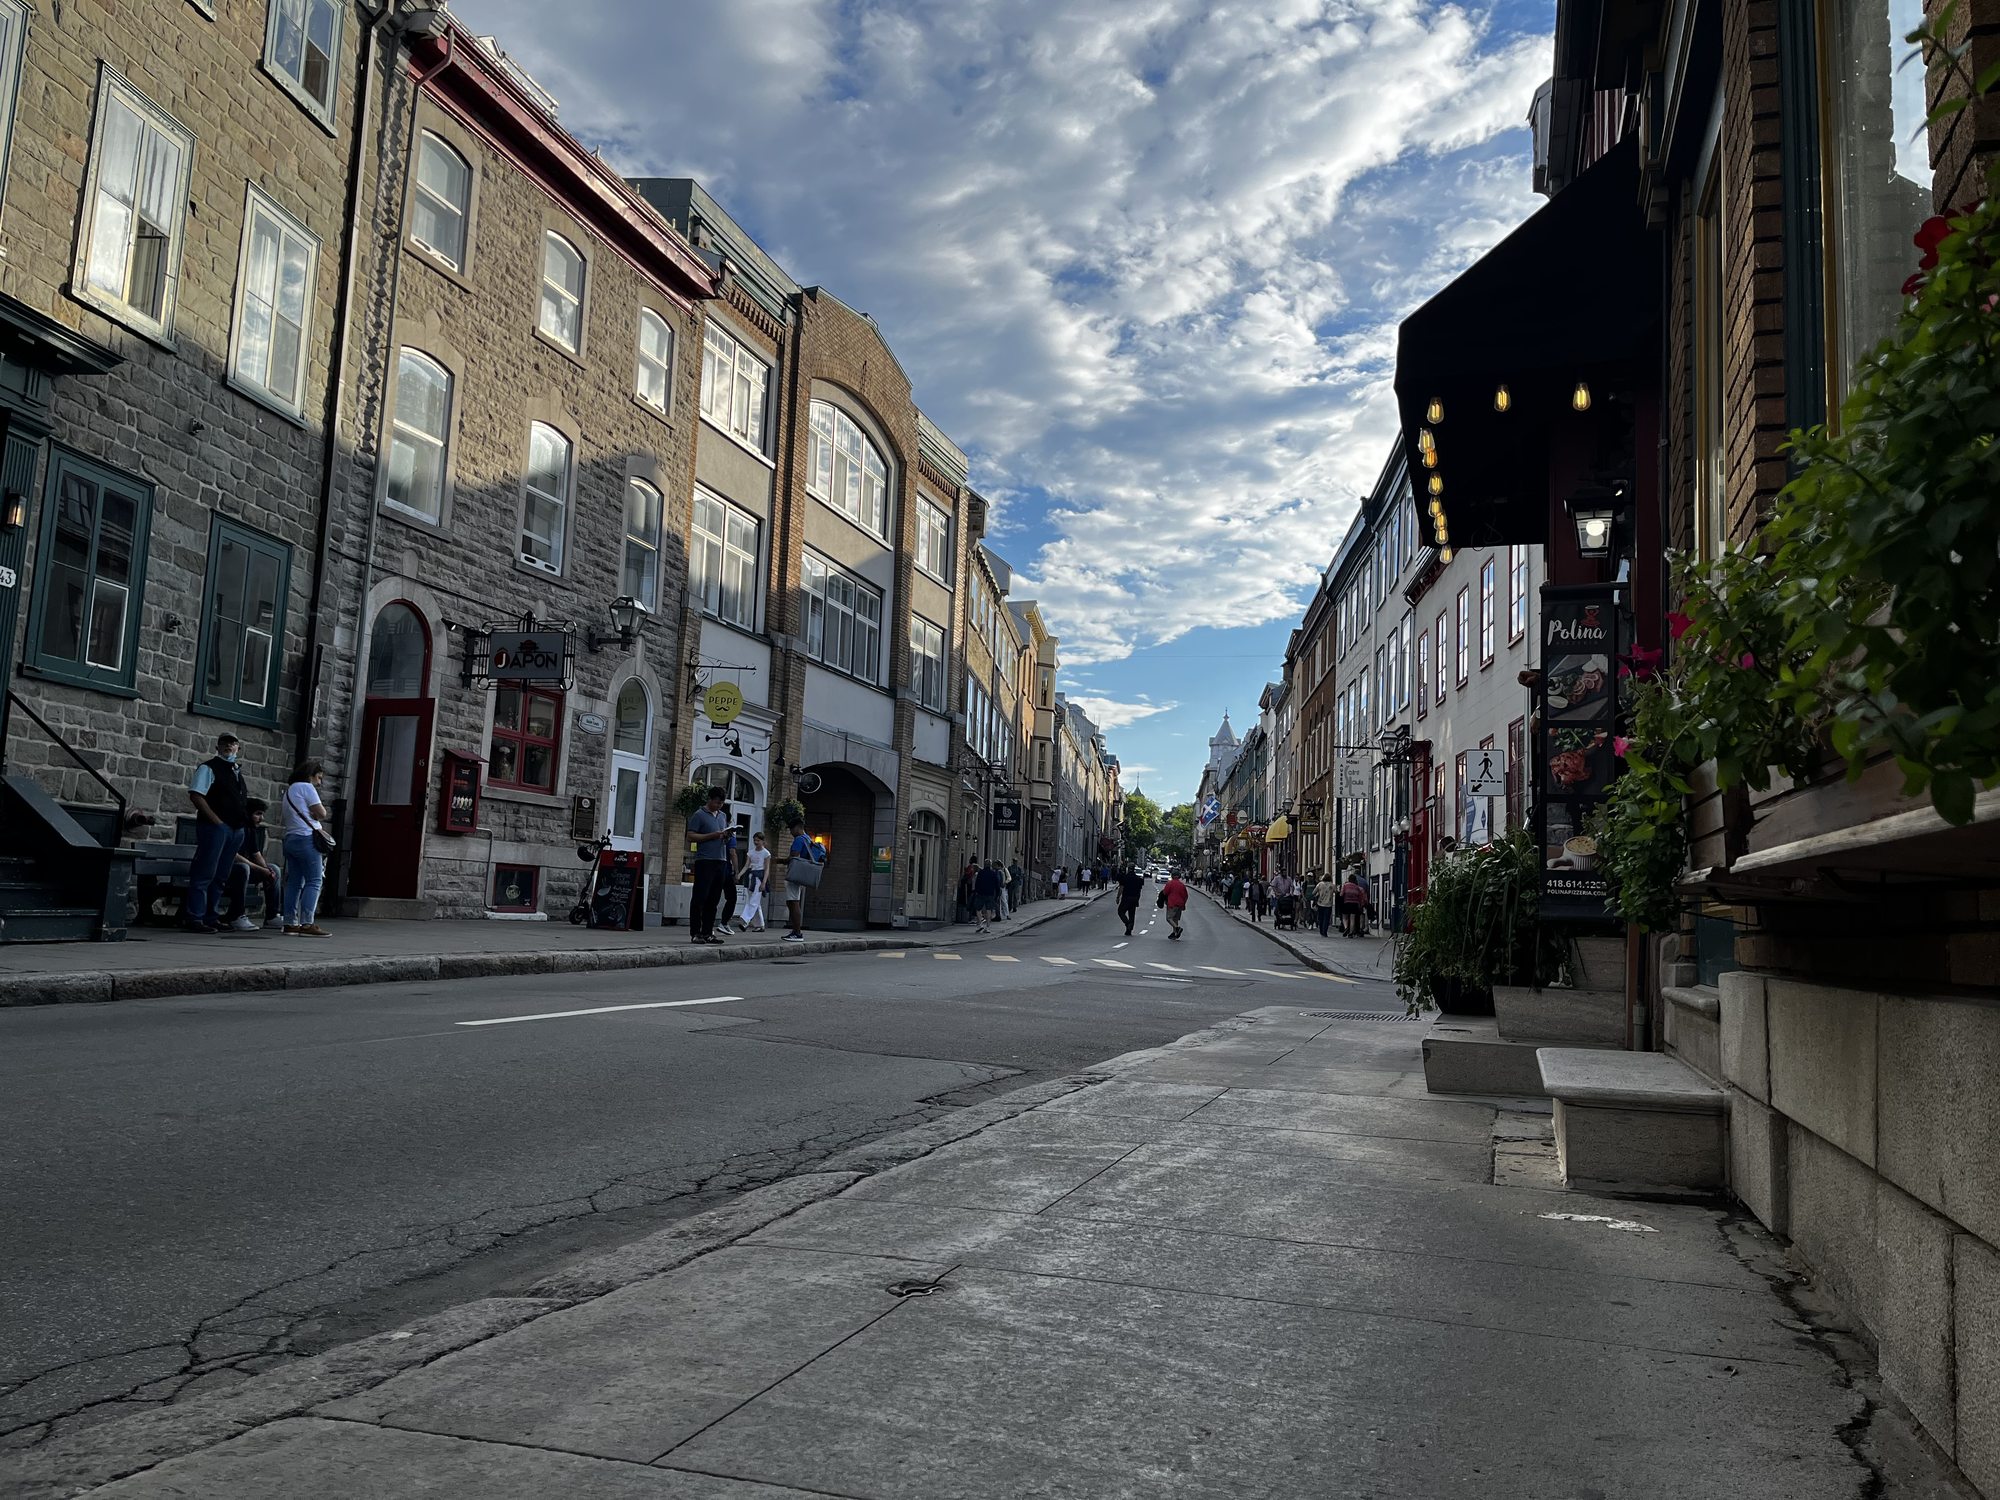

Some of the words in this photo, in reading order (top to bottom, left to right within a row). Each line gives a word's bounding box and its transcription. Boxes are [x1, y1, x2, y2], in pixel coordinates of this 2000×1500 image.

[1547, 618, 1608, 646] Polina
[496, 652, 558, 669] JAPON
[708, 696, 739, 706] PEPPE
